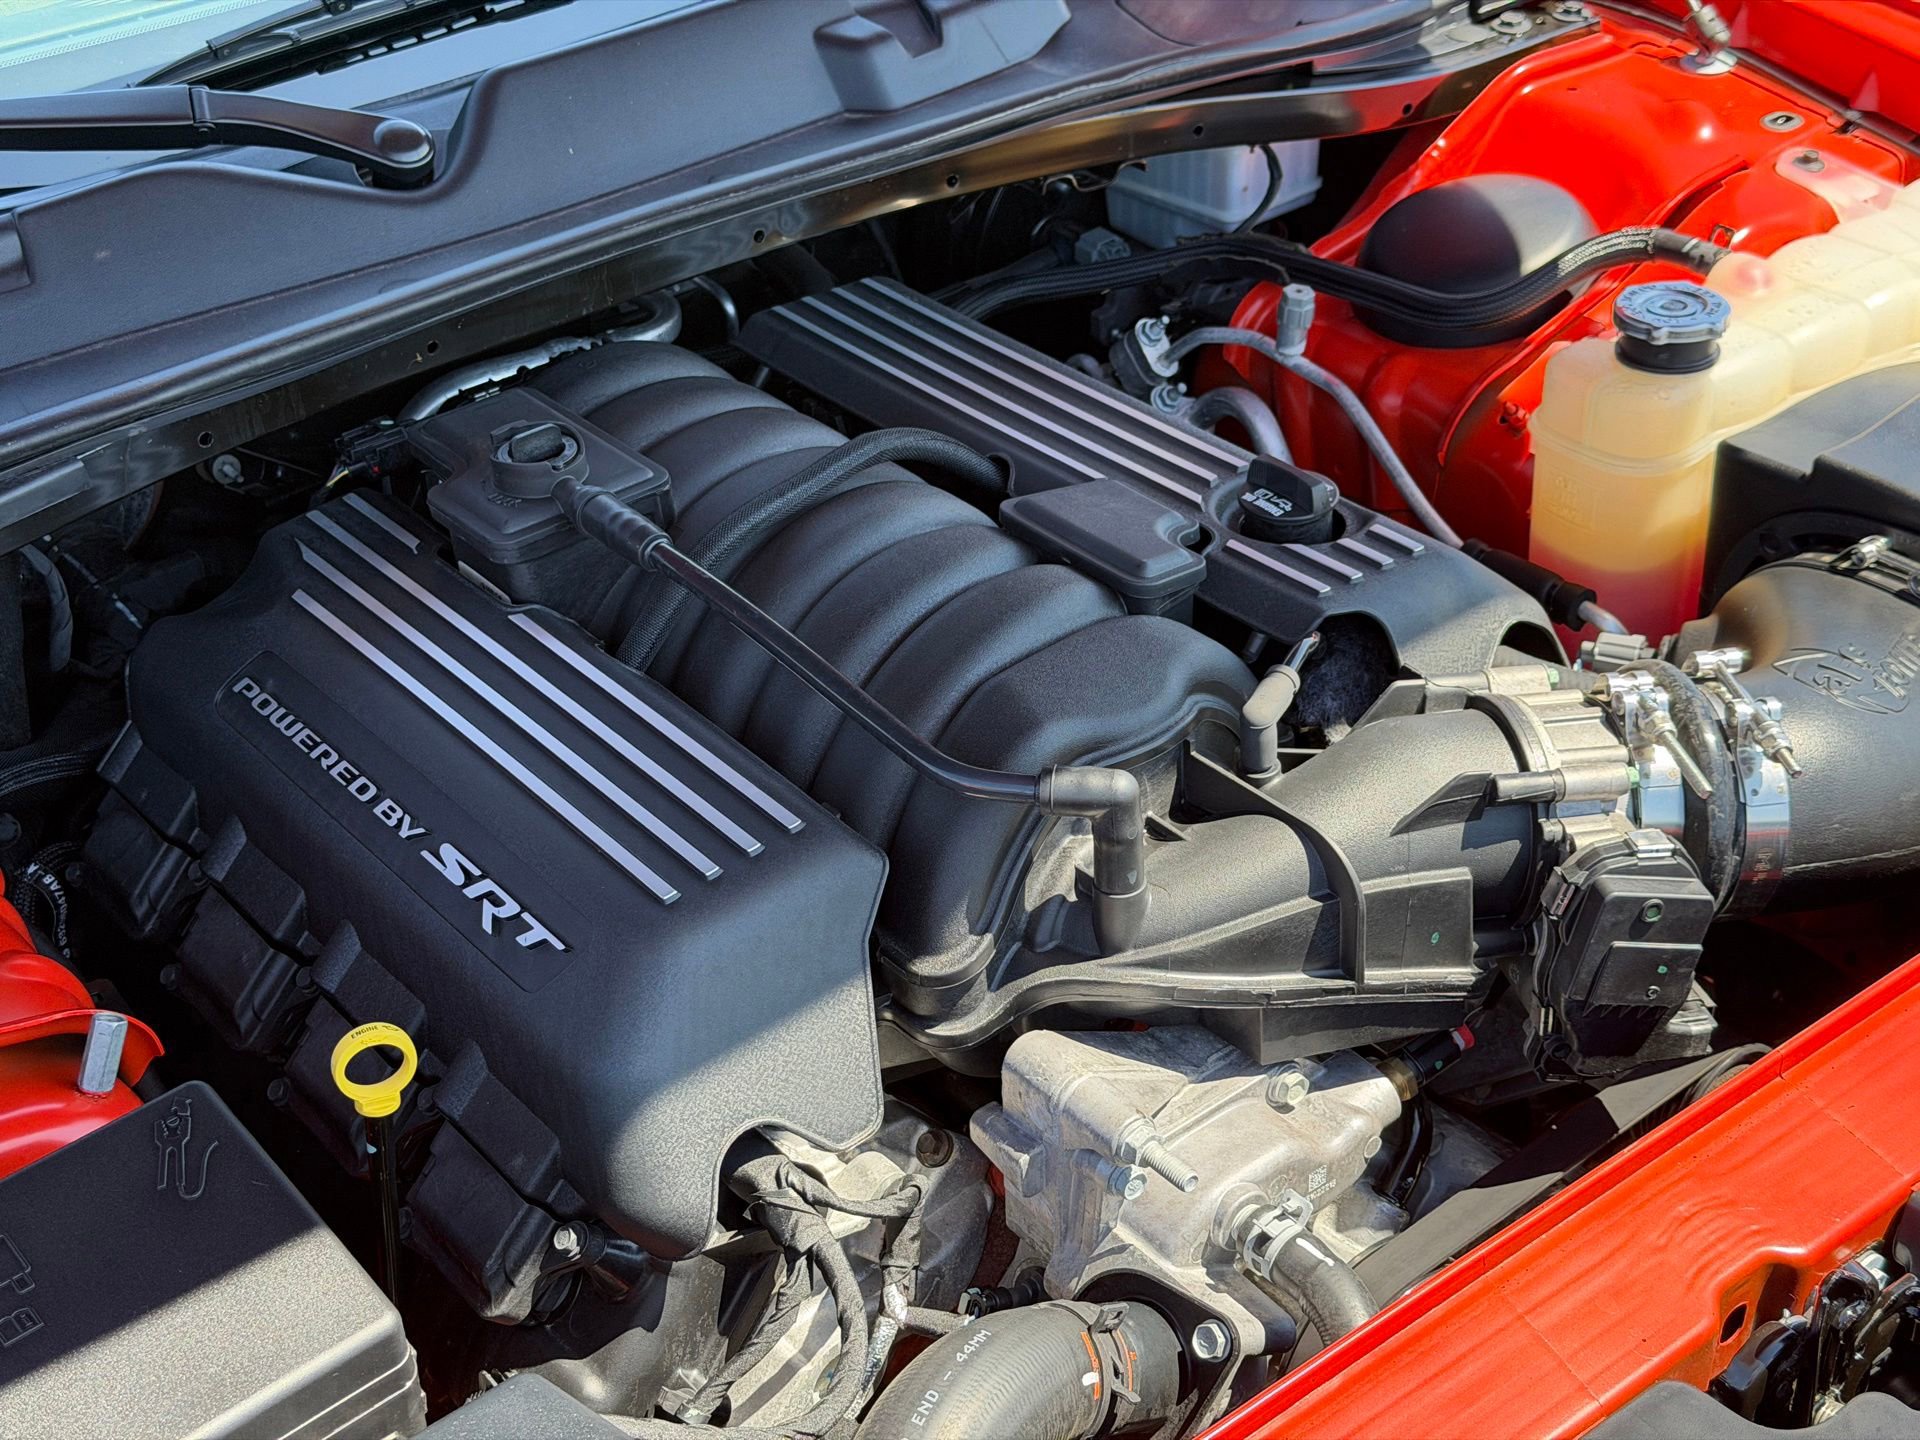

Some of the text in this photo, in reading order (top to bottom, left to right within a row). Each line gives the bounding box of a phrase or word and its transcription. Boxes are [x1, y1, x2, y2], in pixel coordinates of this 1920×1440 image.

[232, 677, 567, 952] POWERED BY SRT
[350, 1025, 379, 1040] ENGINE
[911, 1389, 940, 1427] END
[956, 1329, 992, 1362] 44MM
